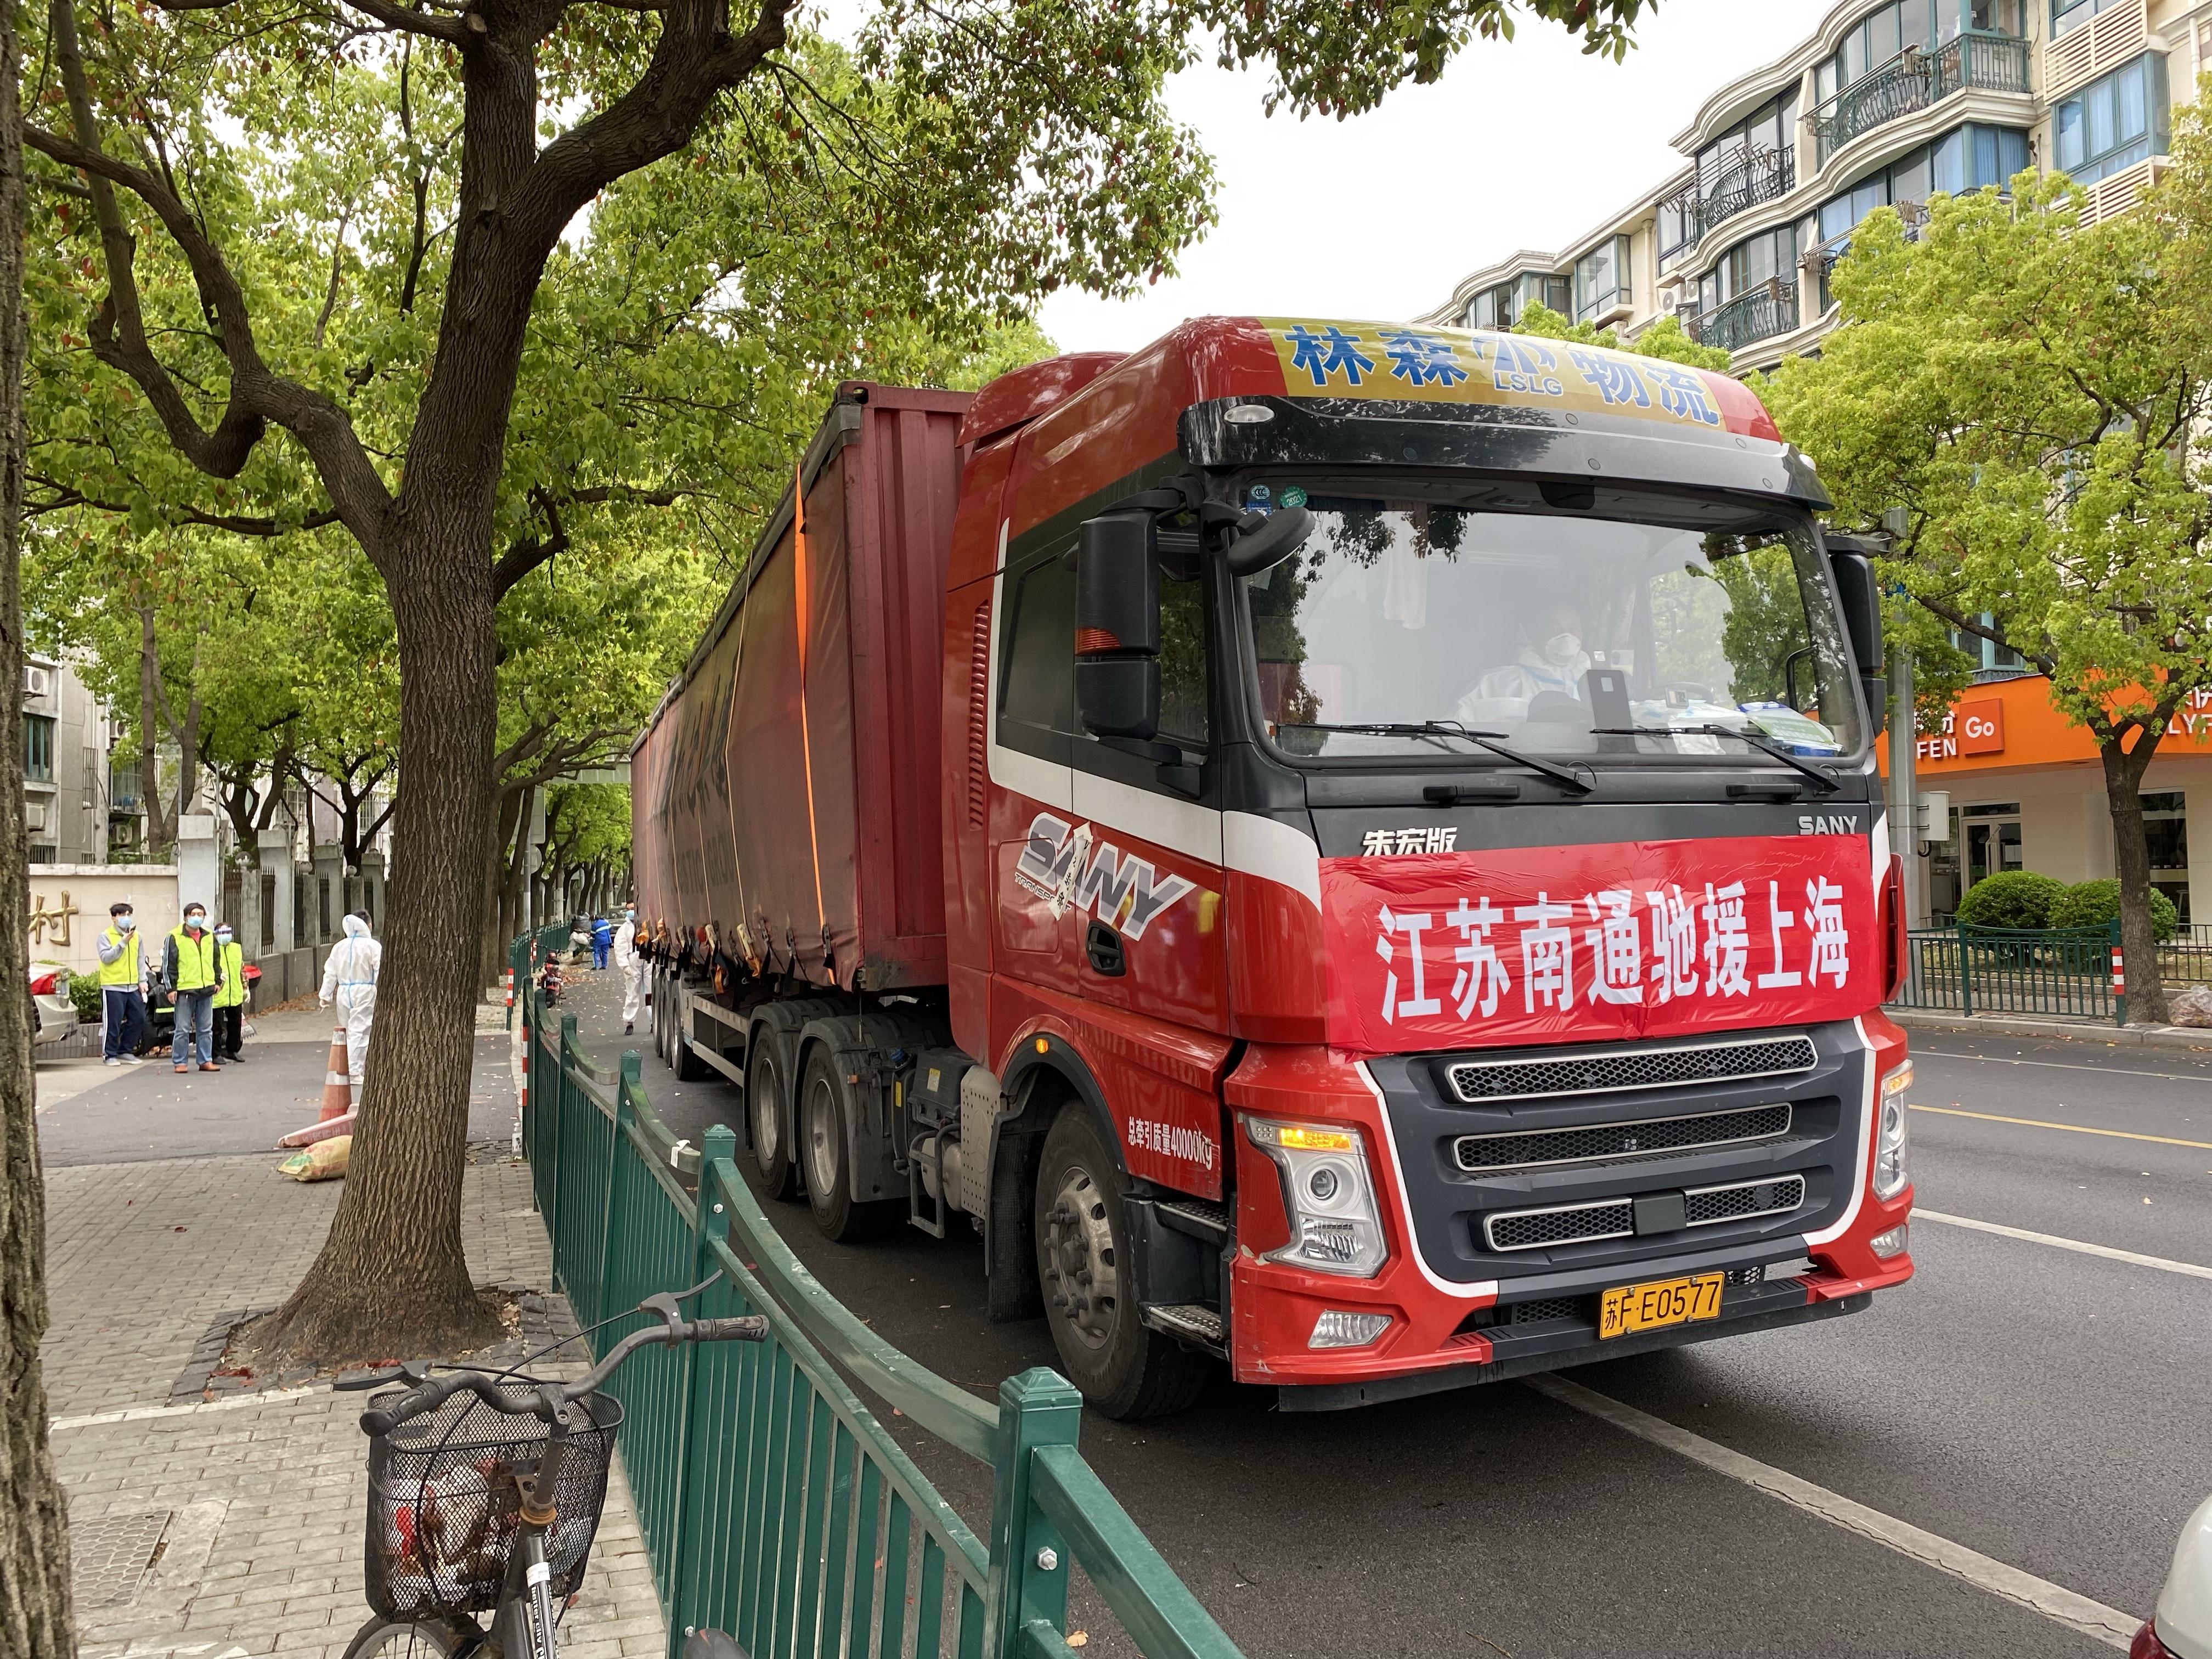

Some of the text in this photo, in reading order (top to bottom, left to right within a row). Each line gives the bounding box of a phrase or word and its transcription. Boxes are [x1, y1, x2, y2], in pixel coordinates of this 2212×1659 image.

[1283, 324, 1723, 426] 林森 物流
[1493, 371, 1563, 397] LSLG
[1286, 494, 1302, 506] 2021
[1965, 716, 1995, 738] Go
[1798, 816, 1858, 836] SANY
[1015, 872, 1073, 914] TRANSPT
[1016, 812, 1198, 941] SANY
[27, 890, 79, 947] 村
[1376, 875, 1849, 1025] 江苏南通驰援上海
